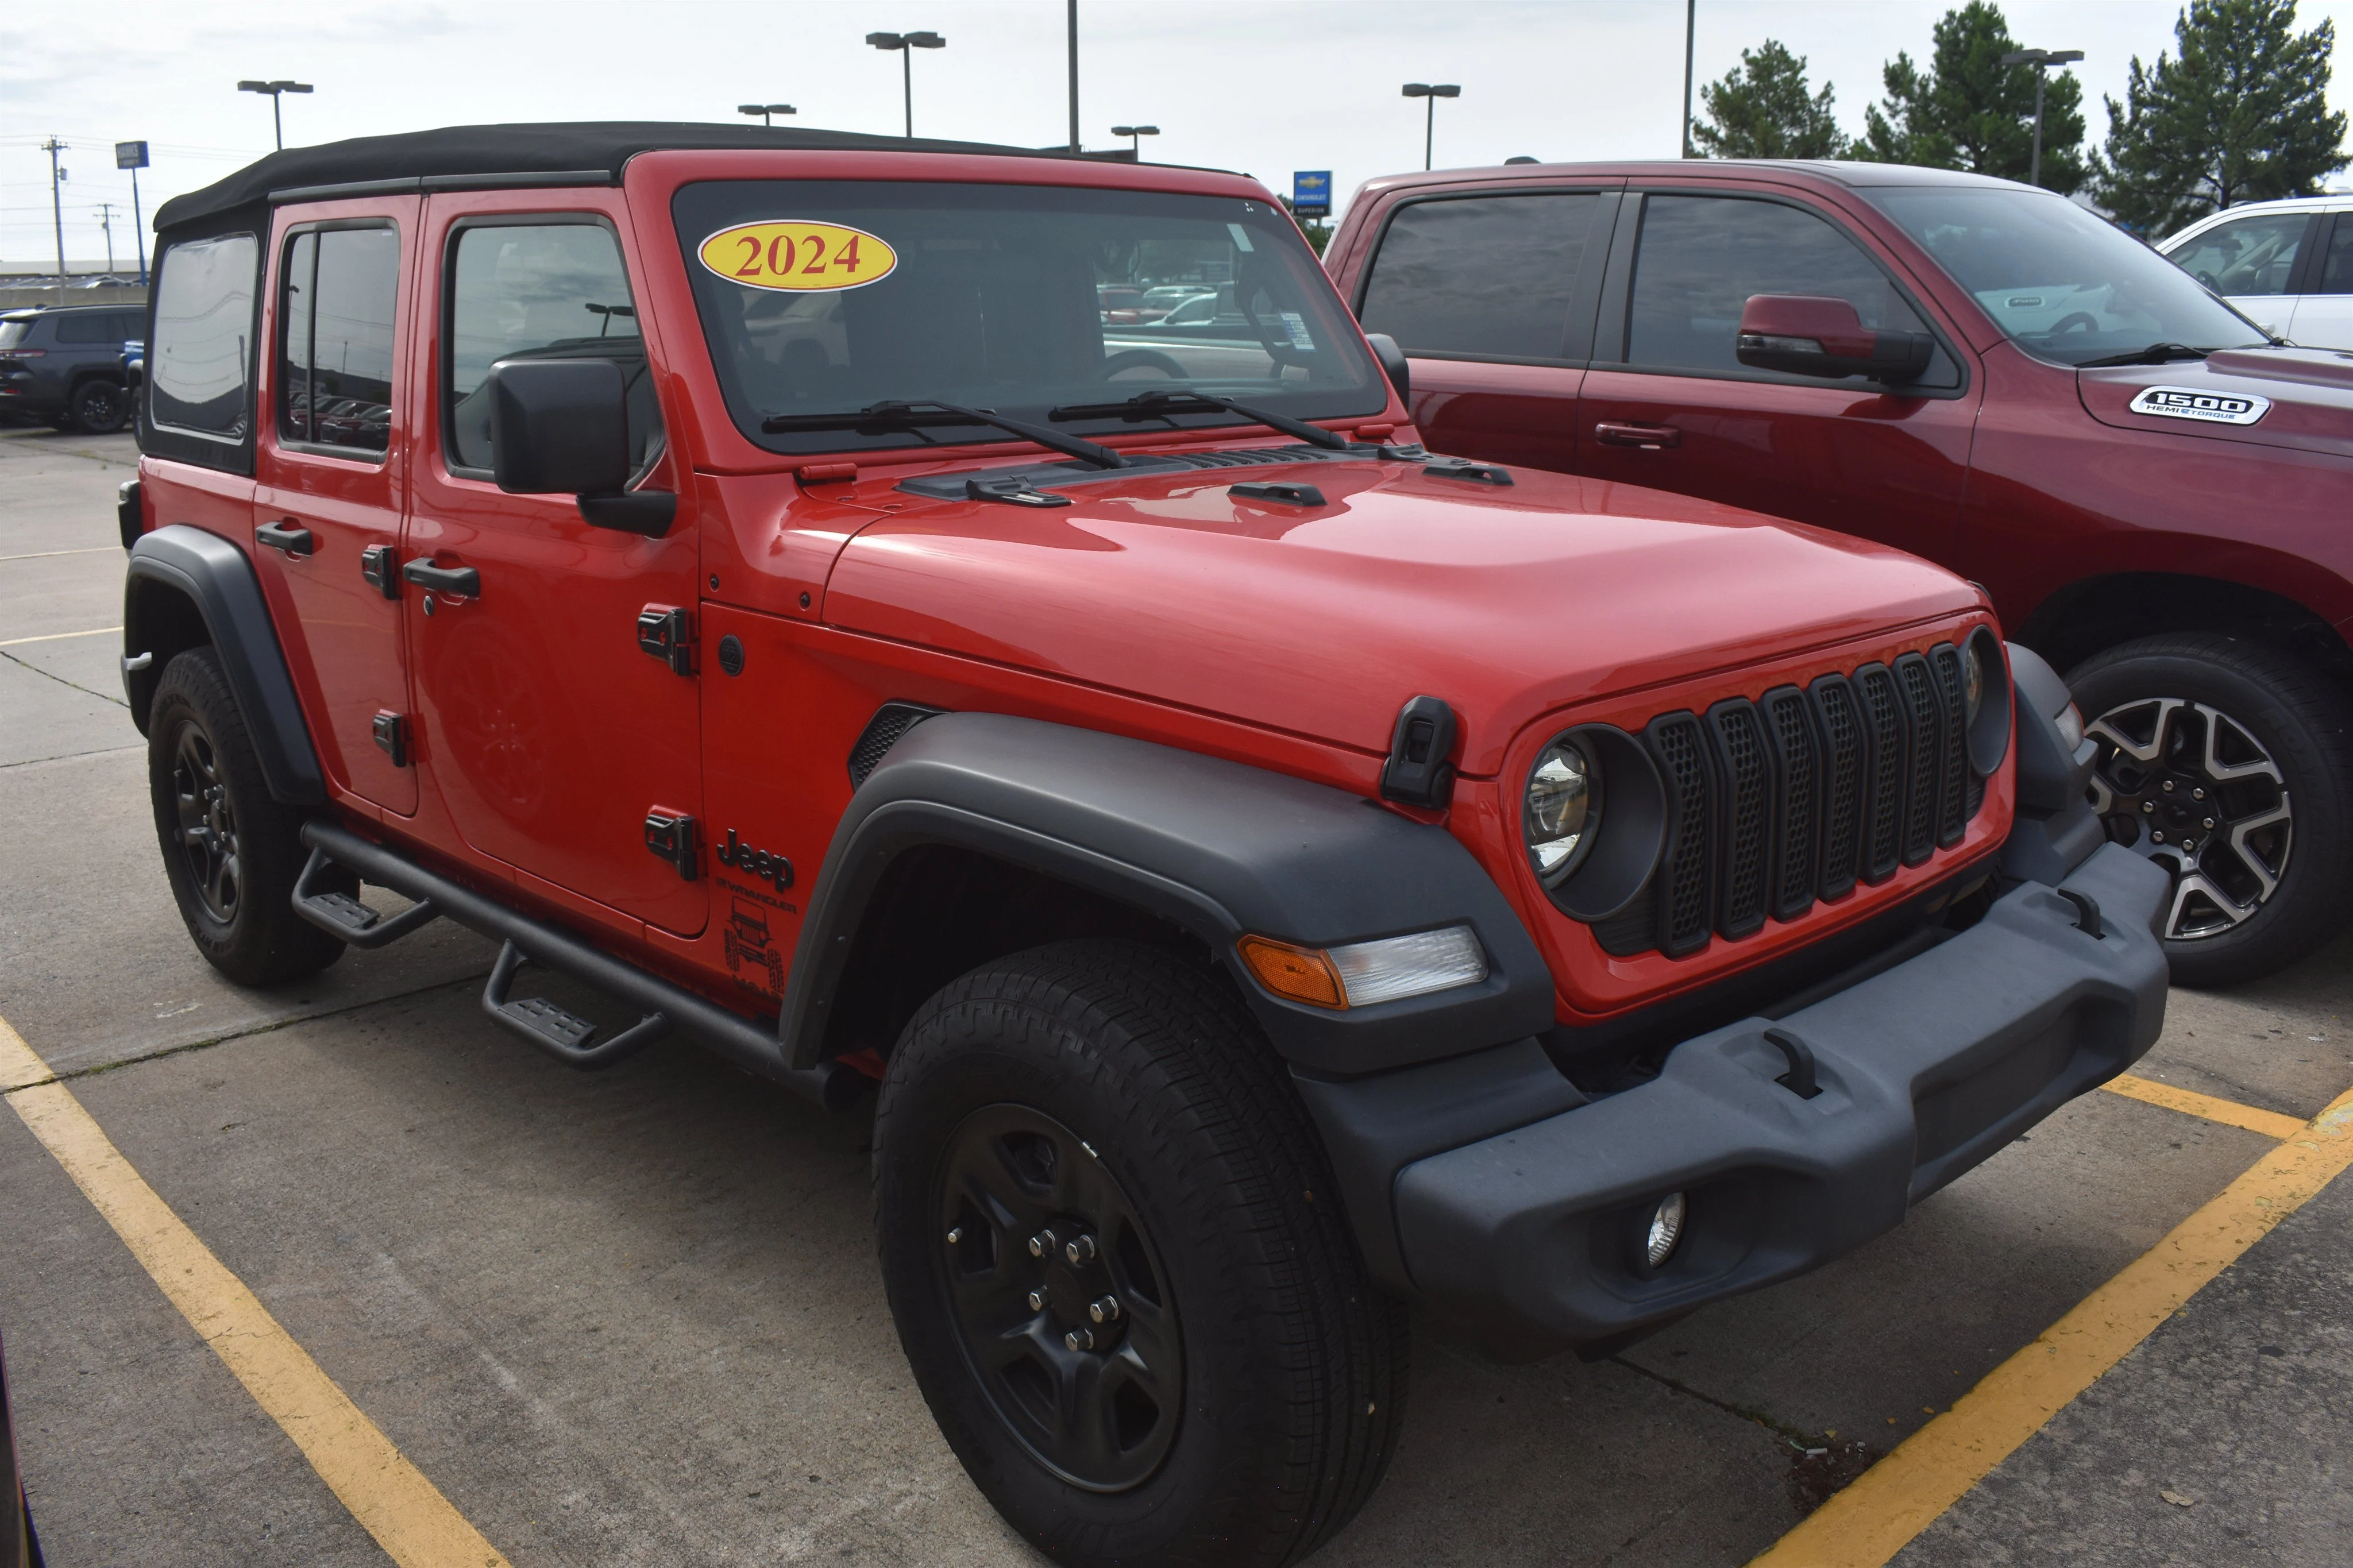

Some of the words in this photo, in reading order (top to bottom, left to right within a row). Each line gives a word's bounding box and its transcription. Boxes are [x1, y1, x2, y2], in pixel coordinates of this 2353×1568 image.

[735, 234, 861, 276] 2024
[2146, 404, 2180, 414] HEMI
[2155, 392, 2247, 413] 1500
[717, 828, 794, 893] Jeep
[728, 880, 797, 914] WRANGLER
